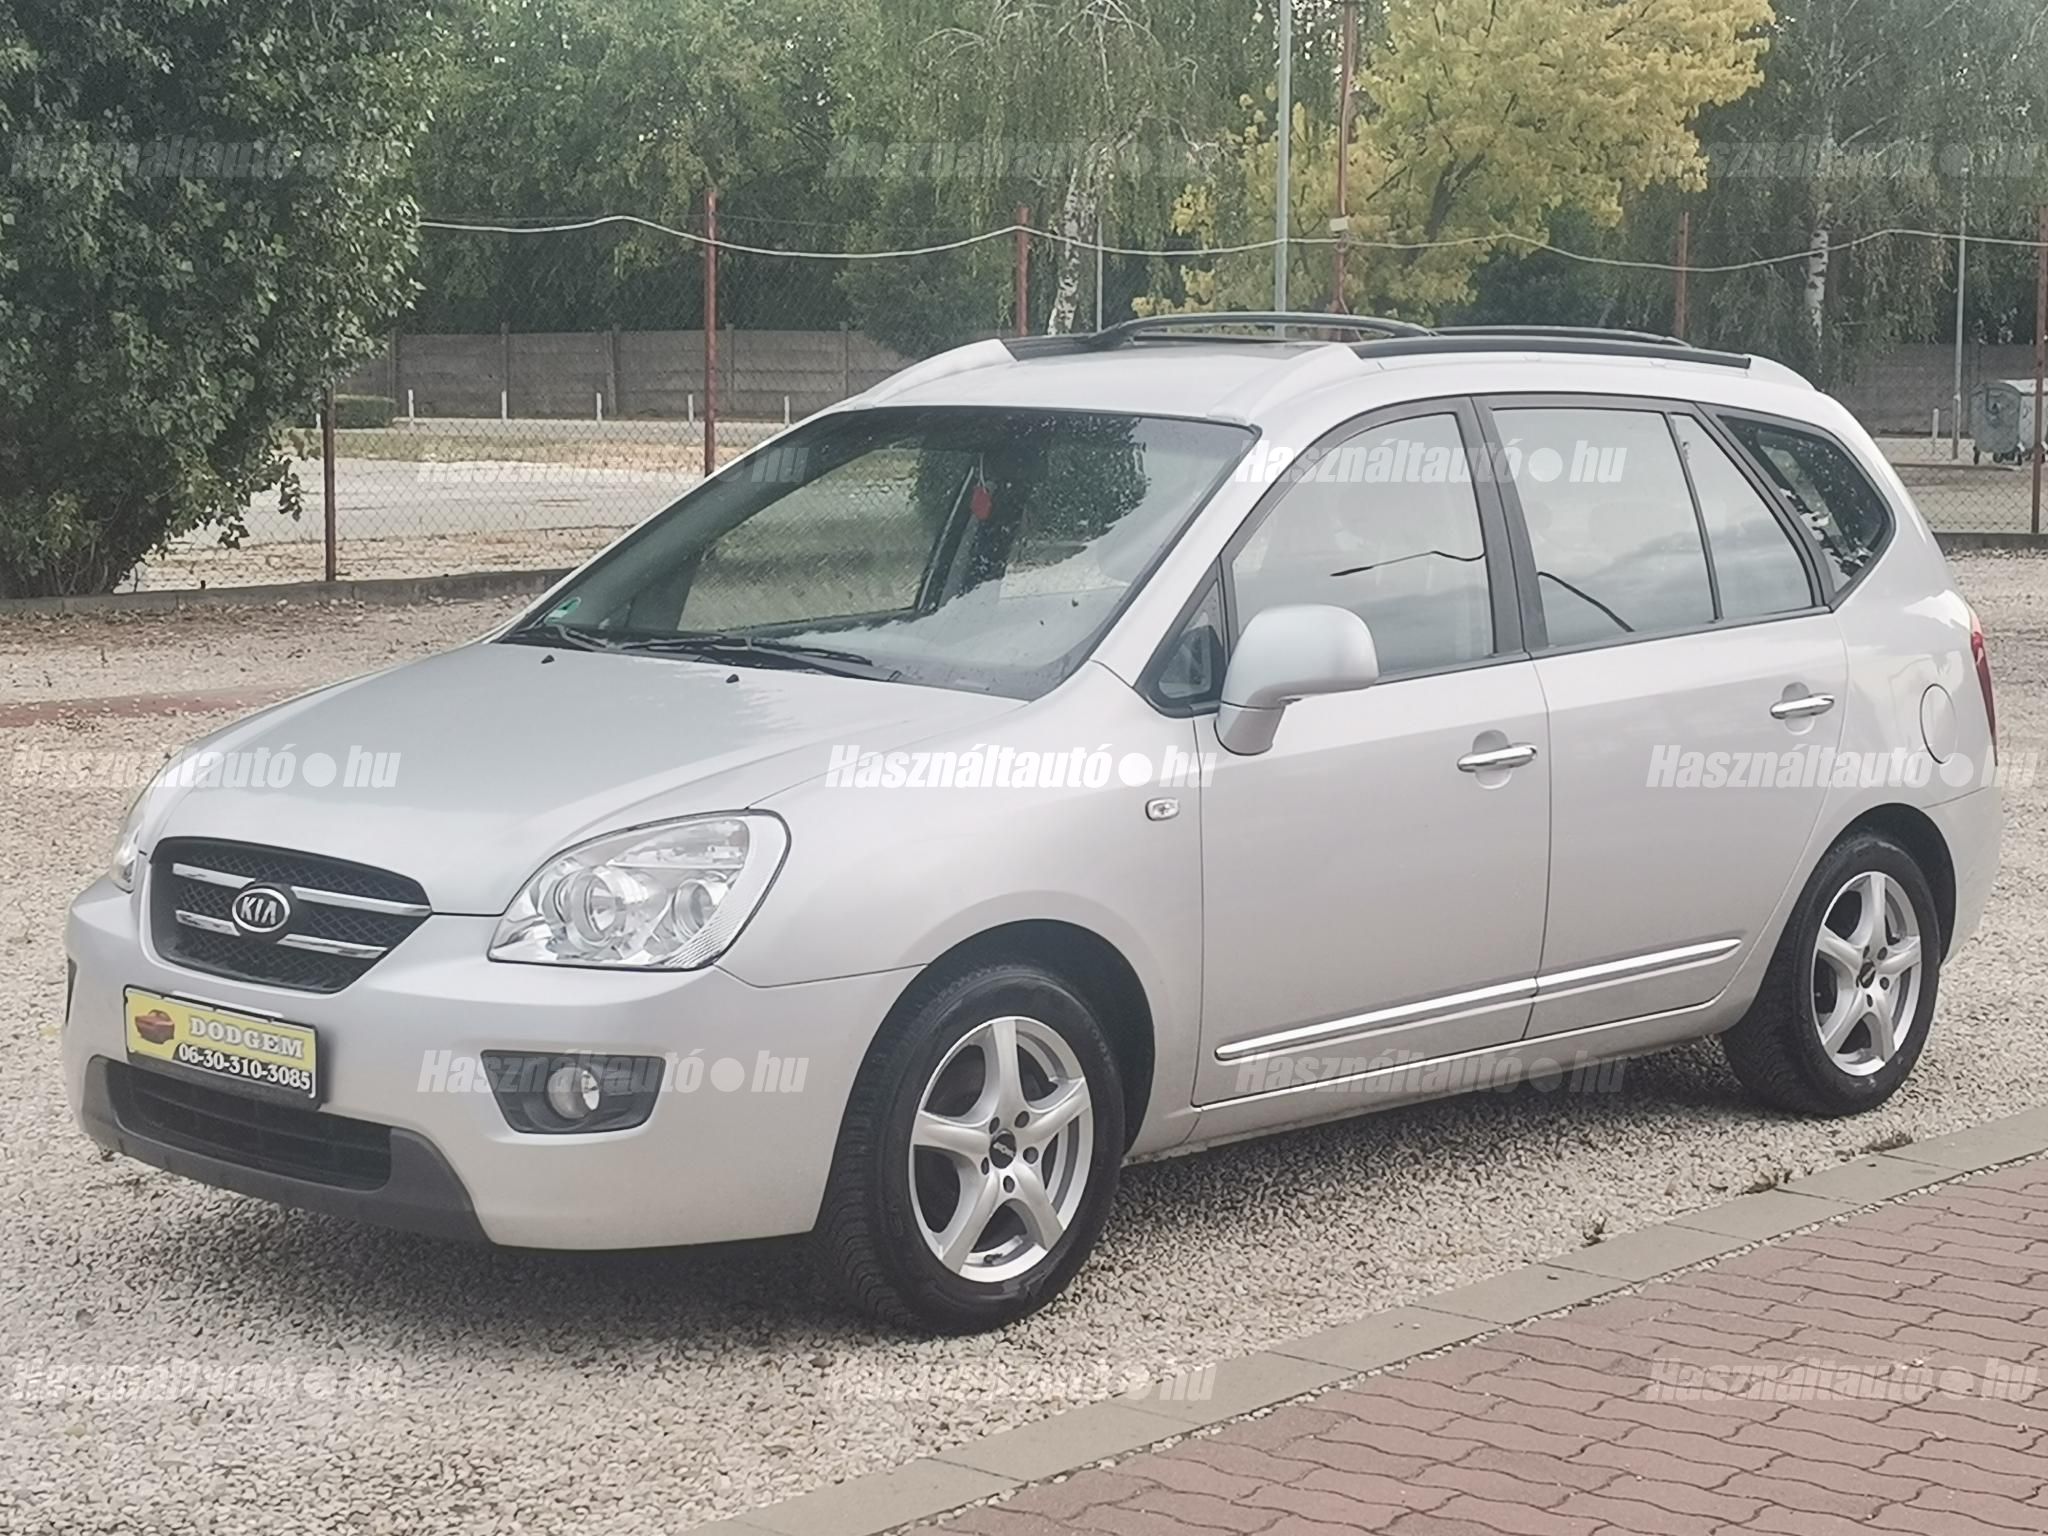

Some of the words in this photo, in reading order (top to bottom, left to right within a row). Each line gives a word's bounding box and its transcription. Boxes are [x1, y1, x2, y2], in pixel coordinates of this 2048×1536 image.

[240, 896, 277, 925] KIA
[188, 1015, 305, 1059] DODGEM
[178, 1043, 311, 1091] 06-30-310-3085
